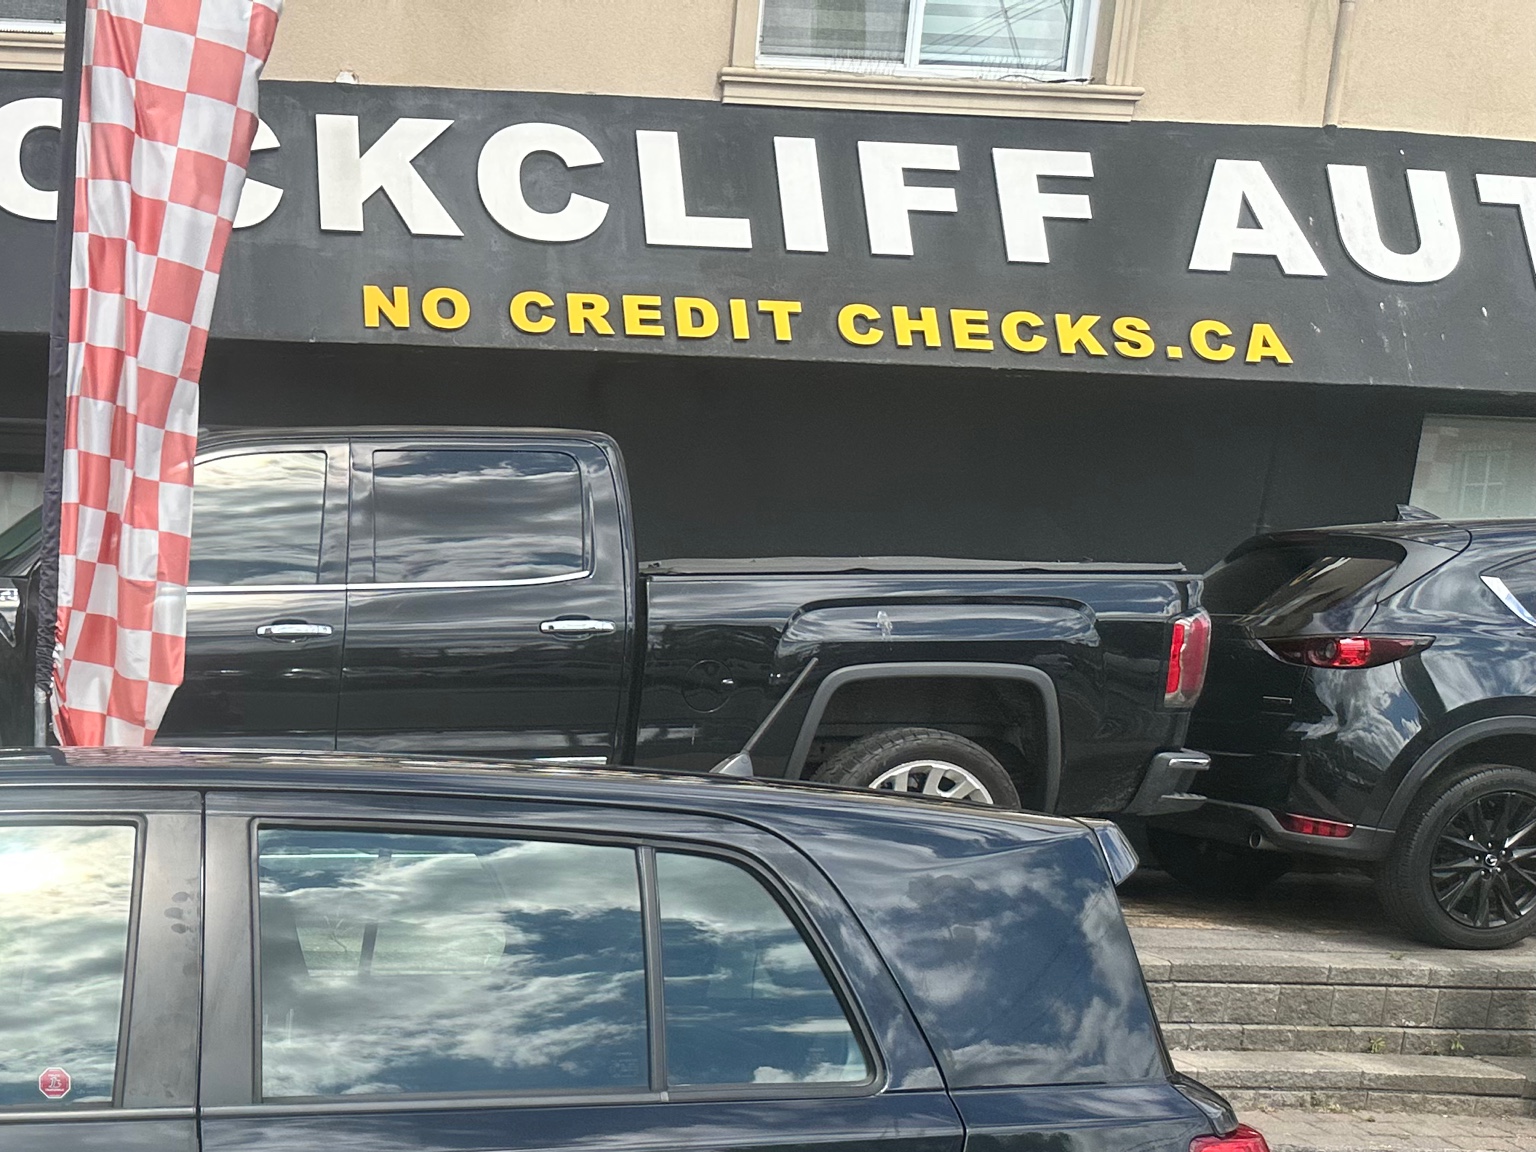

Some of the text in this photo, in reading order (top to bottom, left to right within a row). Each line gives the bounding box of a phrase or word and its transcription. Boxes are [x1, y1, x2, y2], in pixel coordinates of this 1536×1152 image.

[362, 284, 1294, 364] NO CREDIT CHECKS.CA
